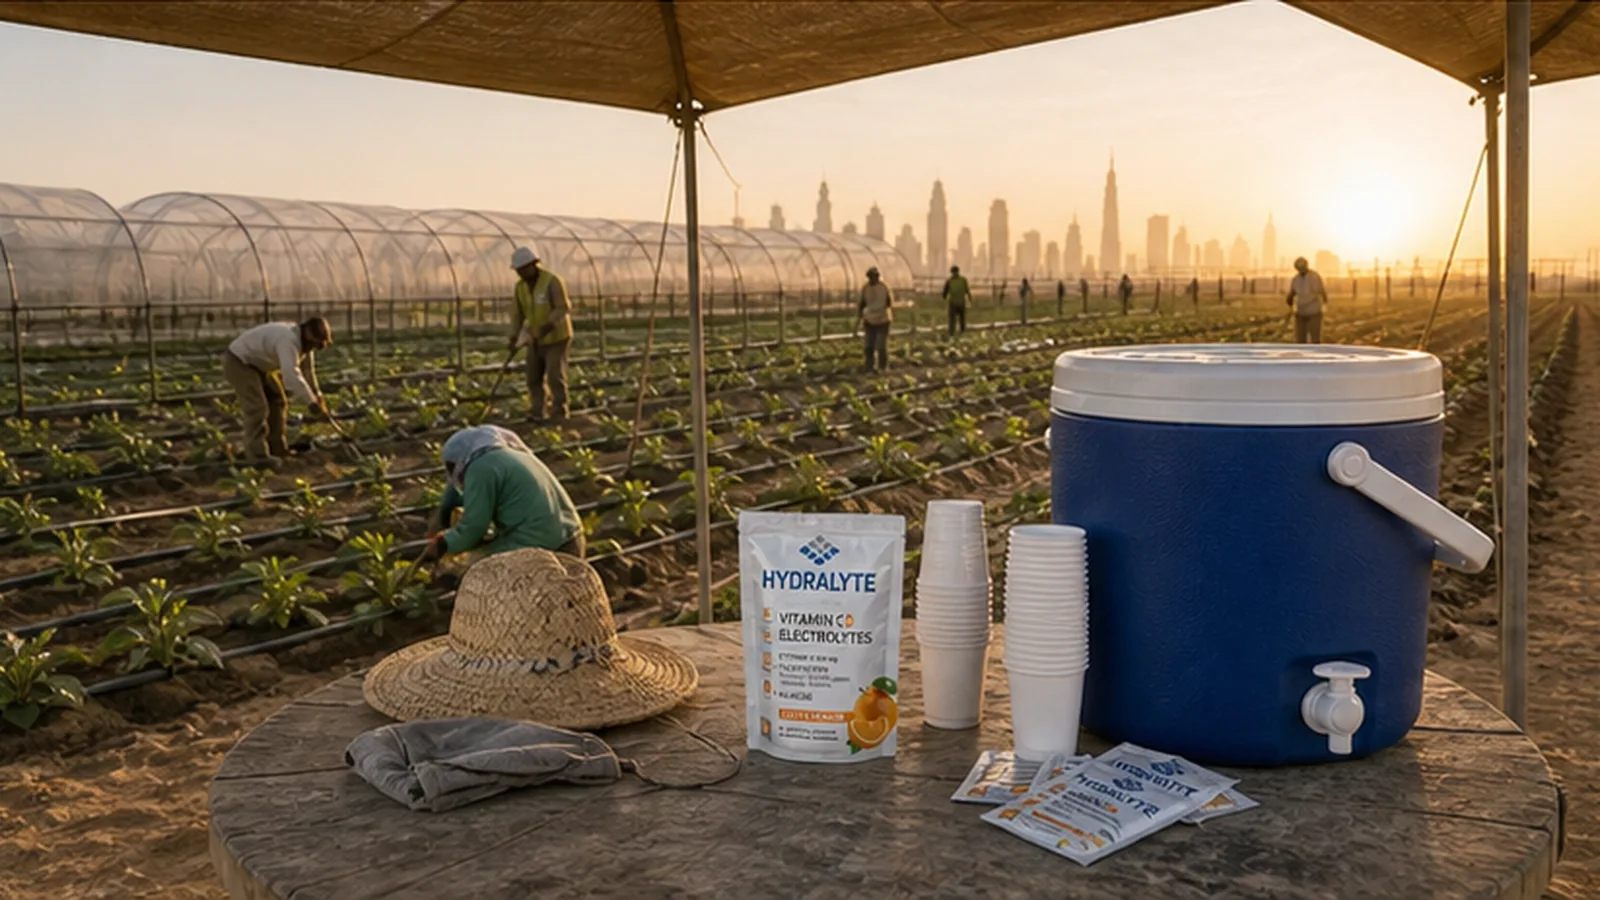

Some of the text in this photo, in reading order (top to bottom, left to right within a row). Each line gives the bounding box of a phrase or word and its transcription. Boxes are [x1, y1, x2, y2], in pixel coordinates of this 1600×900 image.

[762, 569, 877, 593] HYDRALYTE
[779, 612, 834, 627] VITAMIN
[778, 627, 874, 645] ELECTROLYTES
